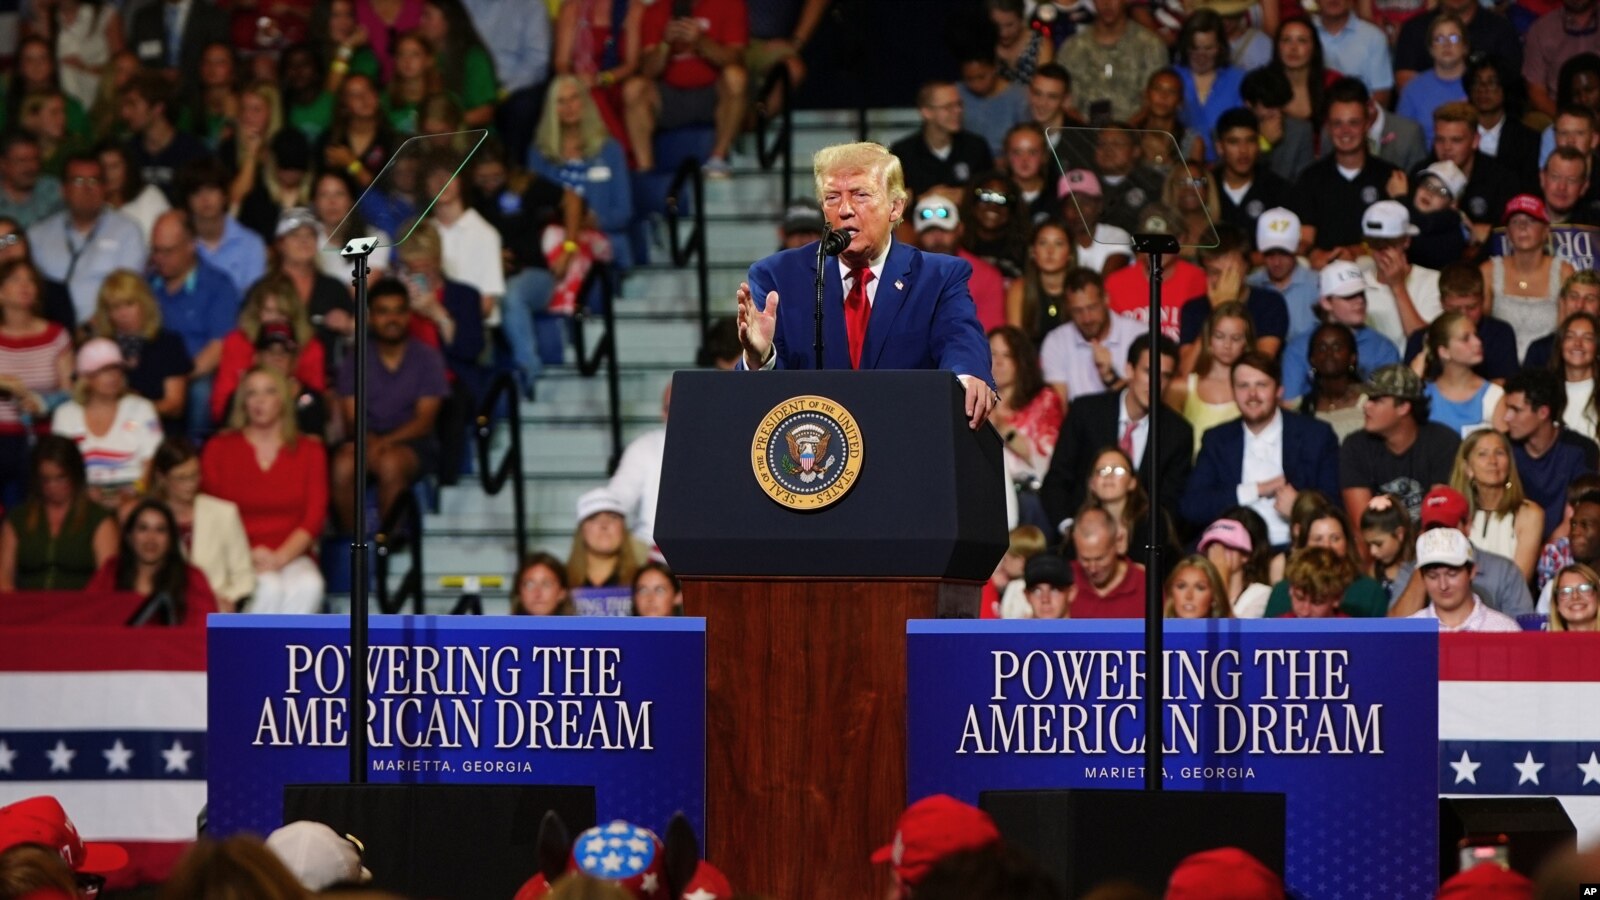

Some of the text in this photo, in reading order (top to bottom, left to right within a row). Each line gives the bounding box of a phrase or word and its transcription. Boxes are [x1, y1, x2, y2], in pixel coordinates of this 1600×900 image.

[755, 399, 860, 505] SEAL OF THE PRESIDENT OF THE UNITED STATES
[285, 644, 622, 697] POWERING THE
[1254, 649, 1350, 700] THE
[494, 699, 654, 750] DREAM
[955, 703, 1385, 754] AMERICN DREAM
[373, 759, 533, 773] MARIETTA, GEORGIA
[1085, 767, 1256, 780] MARIETA, GEORGIA
